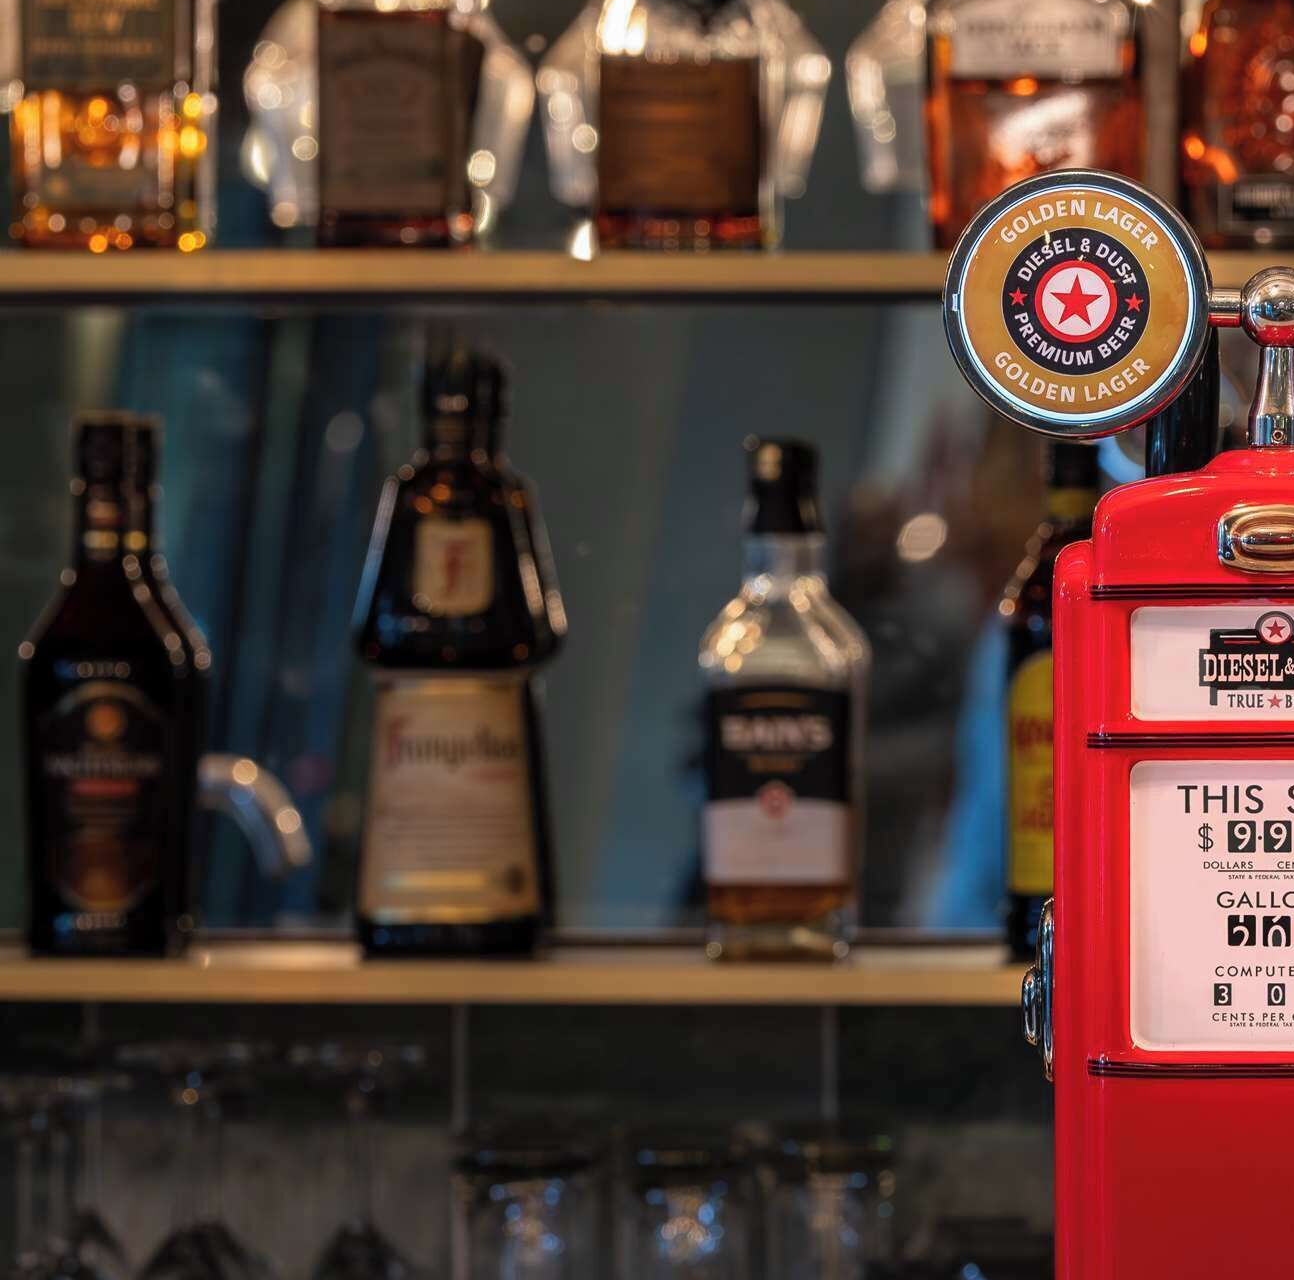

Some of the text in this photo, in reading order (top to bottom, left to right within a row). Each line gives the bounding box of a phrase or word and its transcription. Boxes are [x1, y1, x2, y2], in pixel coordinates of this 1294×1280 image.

[1000, 199, 1159, 251] GOLDEN LAGER
[1018, 238, 1137, 285] DIESEL & DUST
[1014, 312, 1136, 366] PREMIUM BEER
[995, 352, 1151, 402] GOLDEN LAGER
[1227, 693, 1265, 709] TRUE
[1177, 785, 1264, 814] THIS
[1197, 823, 1214, 852] $
[1203, 861, 1254, 870] DOLLARS
[1218, 985, 1283, 1004] 3 0
[1212, 1013, 1255, 1022] CENTS
[1262, 1013, 1285, 1022] PER
